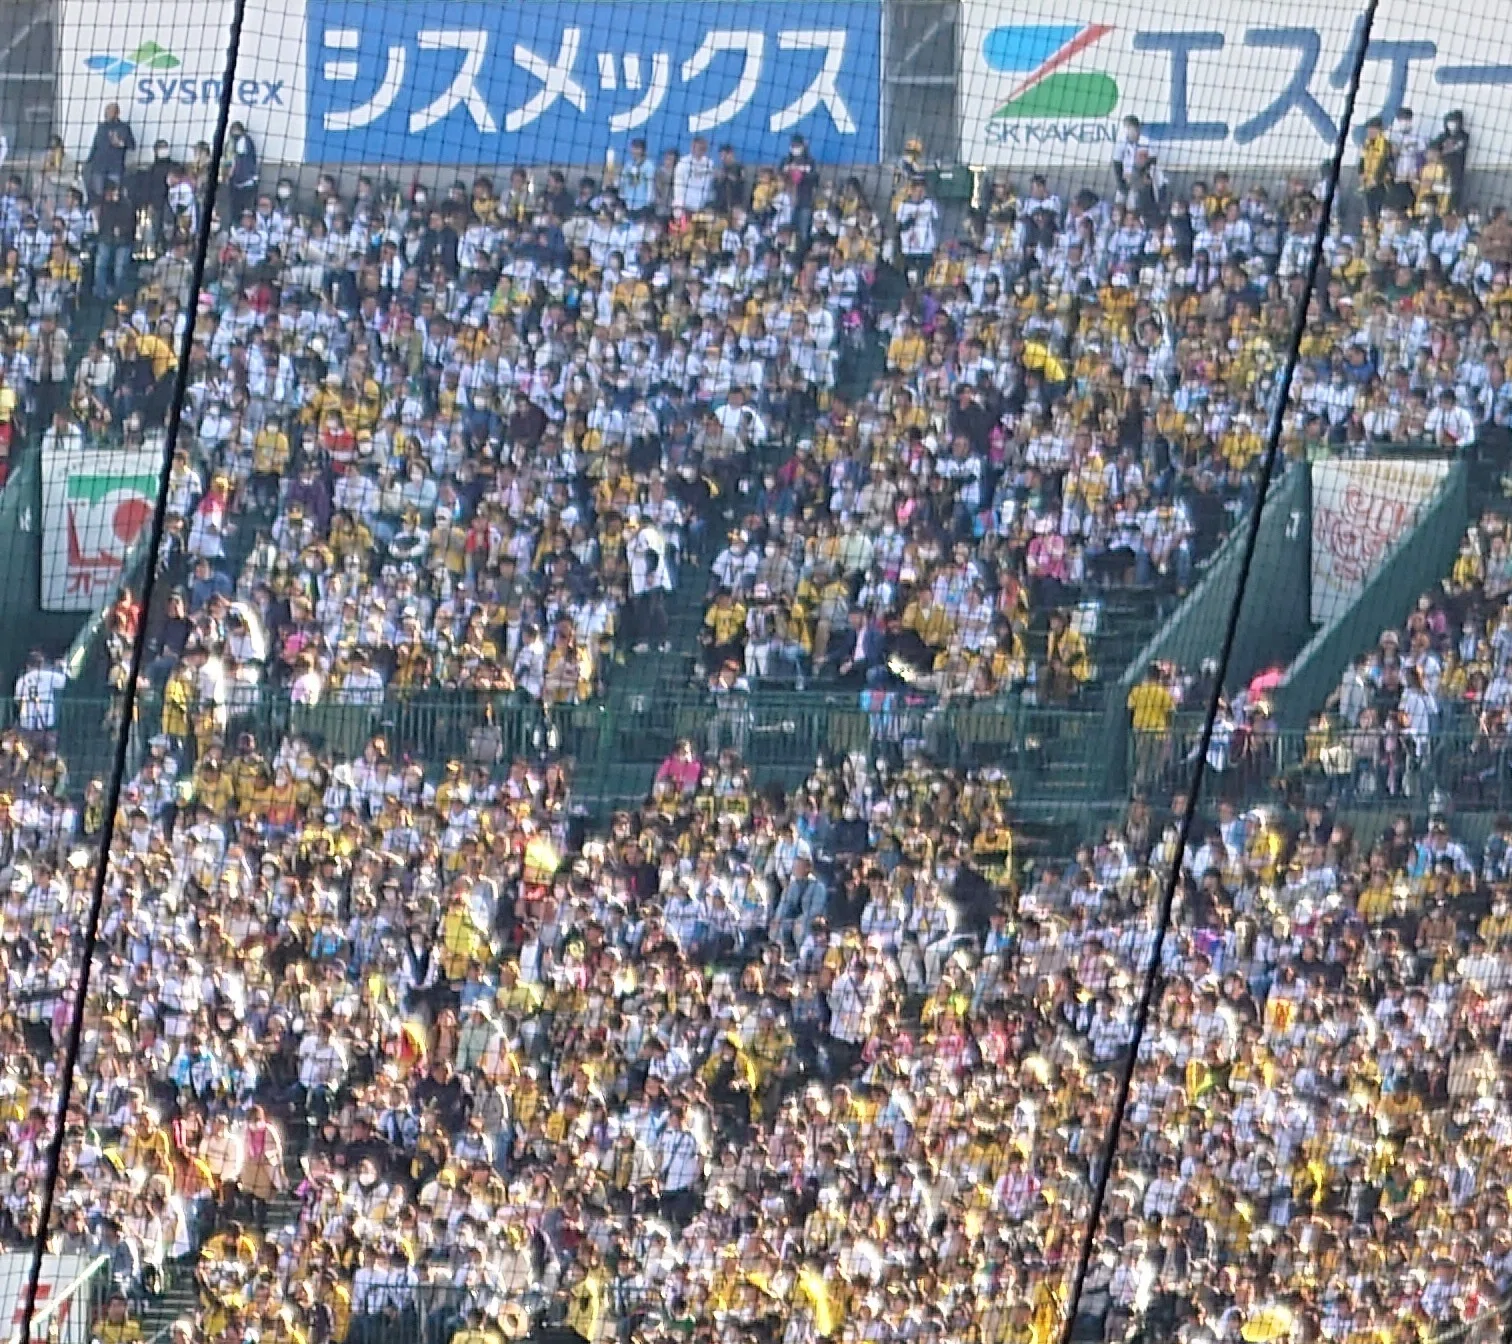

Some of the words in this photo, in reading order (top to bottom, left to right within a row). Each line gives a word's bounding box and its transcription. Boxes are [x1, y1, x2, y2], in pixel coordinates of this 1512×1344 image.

[137, 78, 285, 105] sysmex
[322, 26, 858, 135] シスメックス
